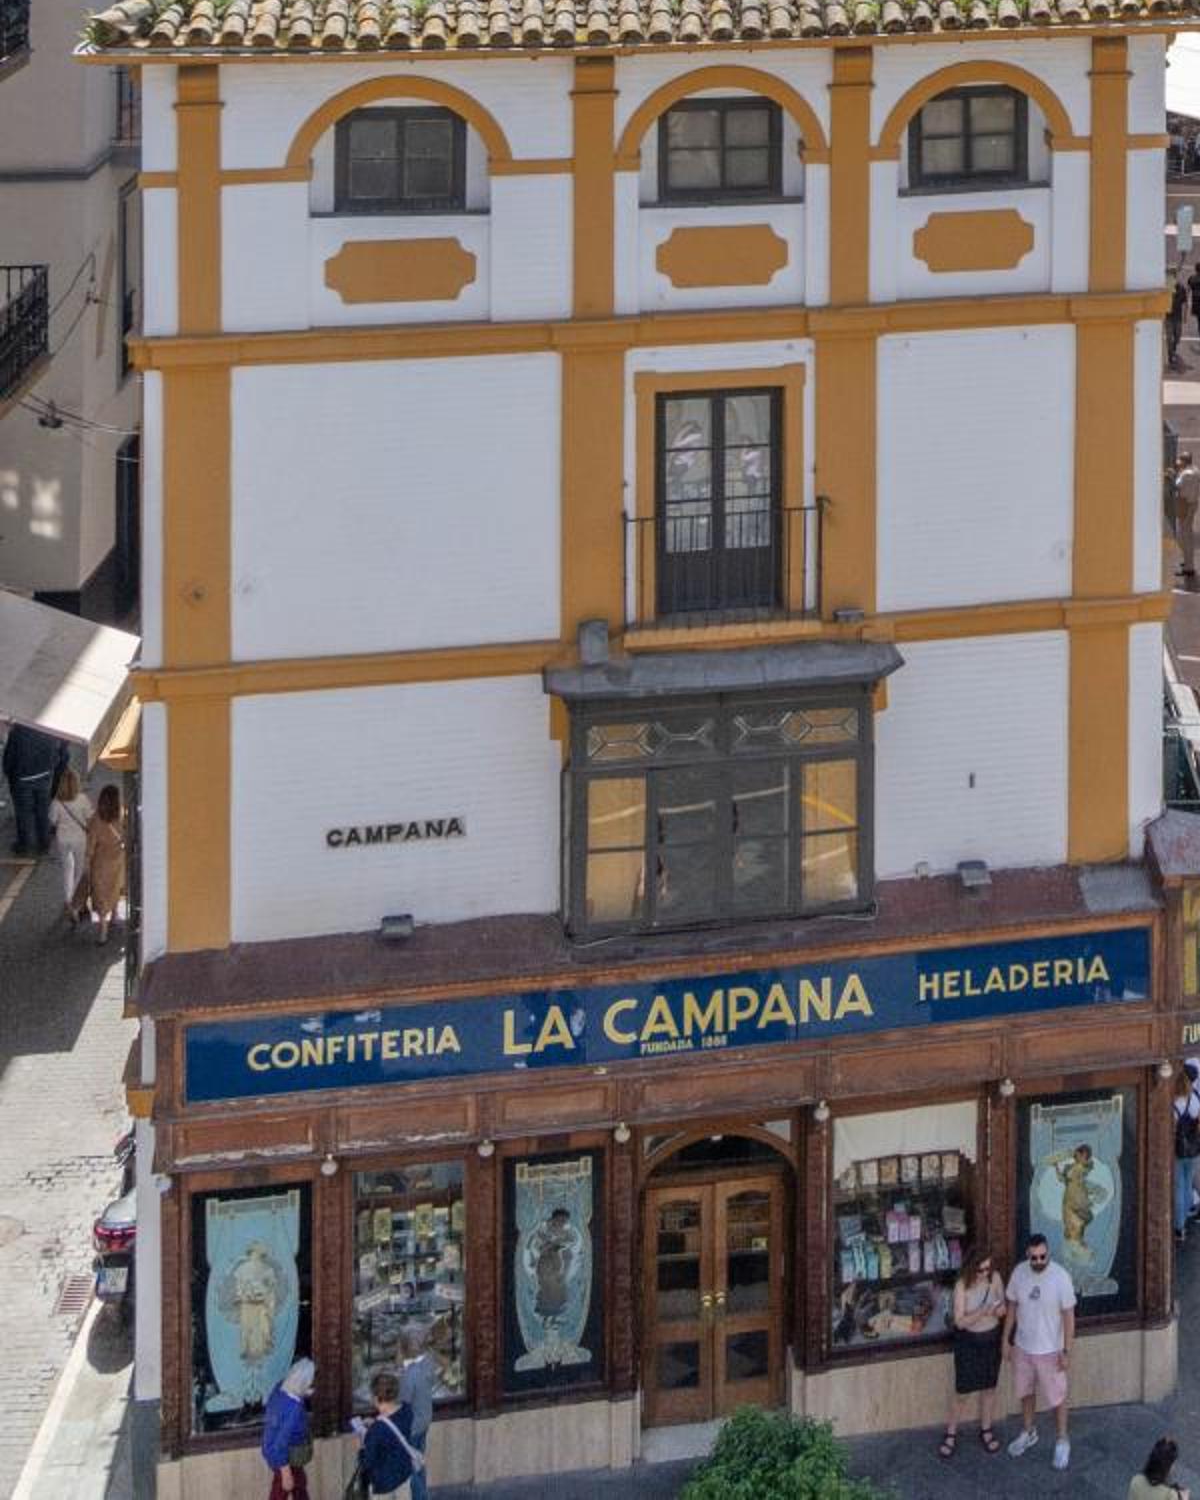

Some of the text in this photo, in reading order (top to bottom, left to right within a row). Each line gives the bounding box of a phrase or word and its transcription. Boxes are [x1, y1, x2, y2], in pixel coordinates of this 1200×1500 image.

[326, 817, 463, 847] CAMPANA
[247, 955, 1110, 1071] CONFITERIA LA CAMPANA HELADERIA
[641, 1038, 693, 1055] FUNDADA
